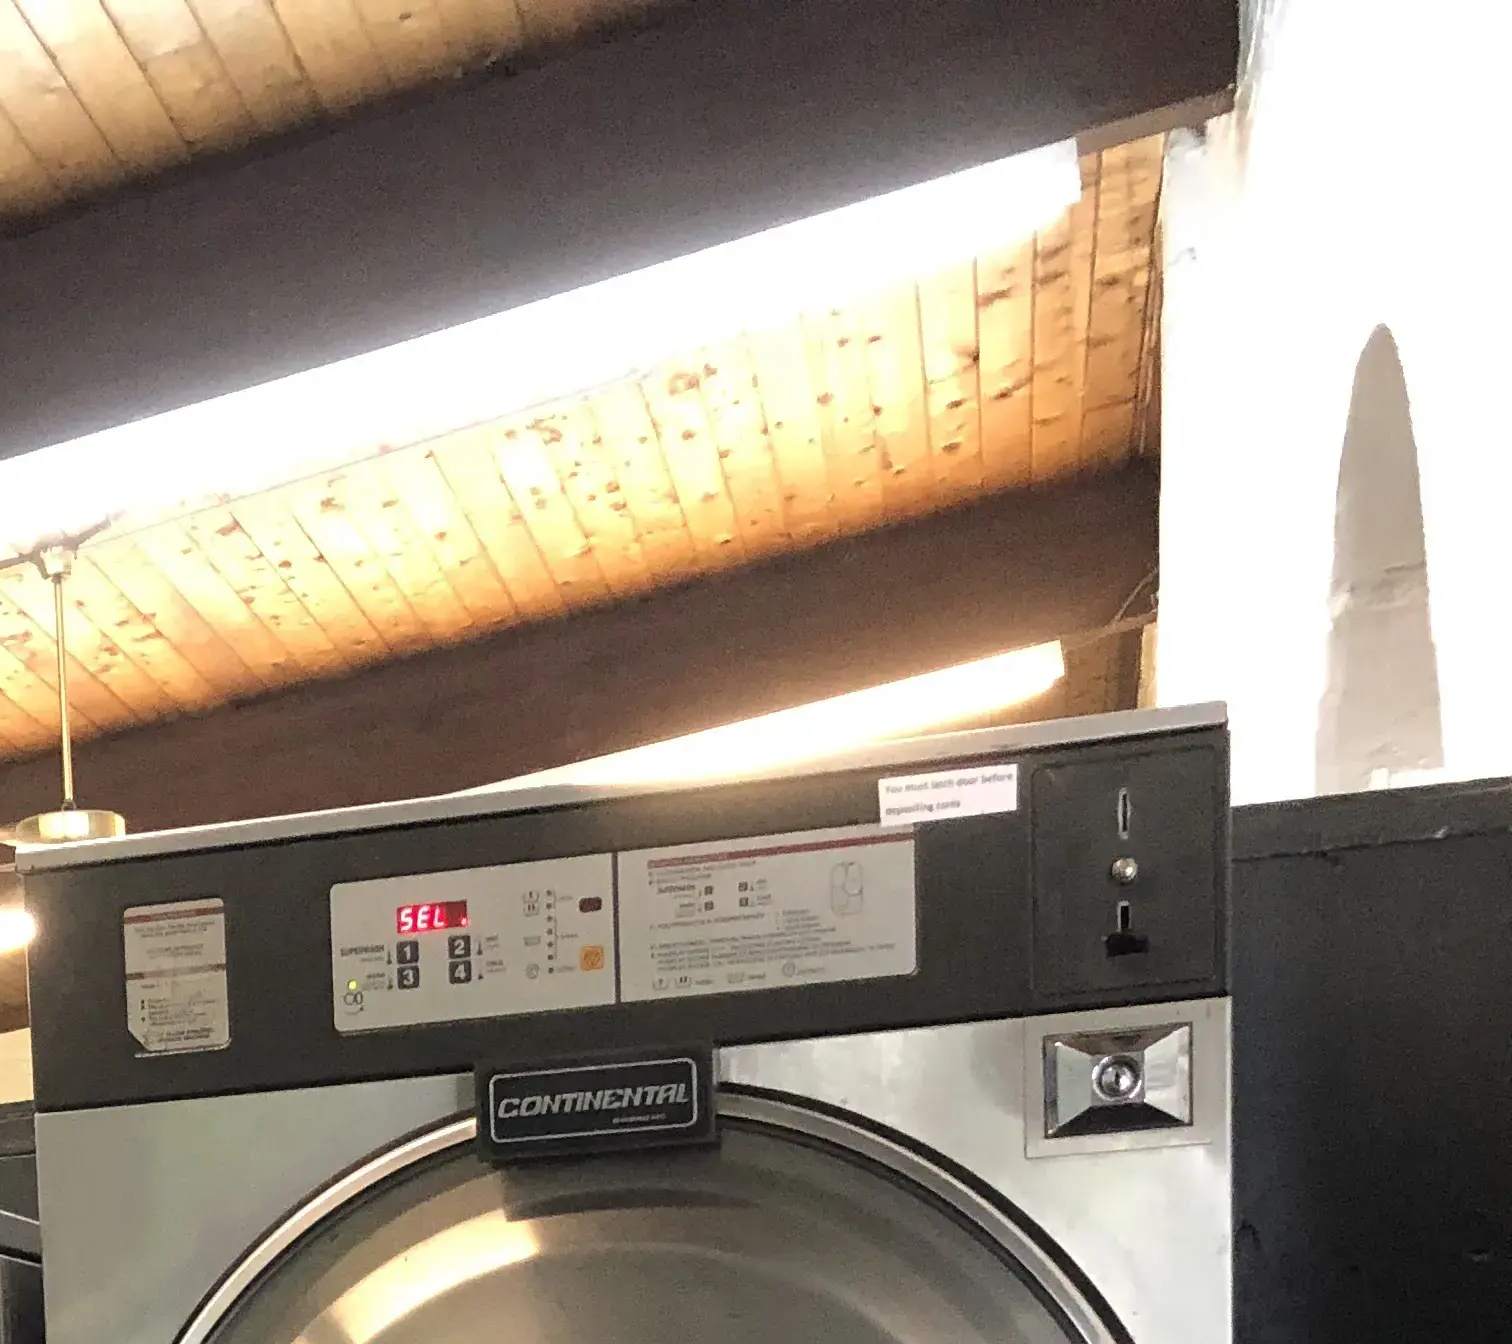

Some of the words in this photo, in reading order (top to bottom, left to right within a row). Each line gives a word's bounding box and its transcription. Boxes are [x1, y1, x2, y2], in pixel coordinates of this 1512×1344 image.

[956, 776, 979, 787] door
[981, 773, 1013, 784] before
[399, 904, 445, 932] SEL
[497, 1083, 689, 1119] CONTINENTAL
